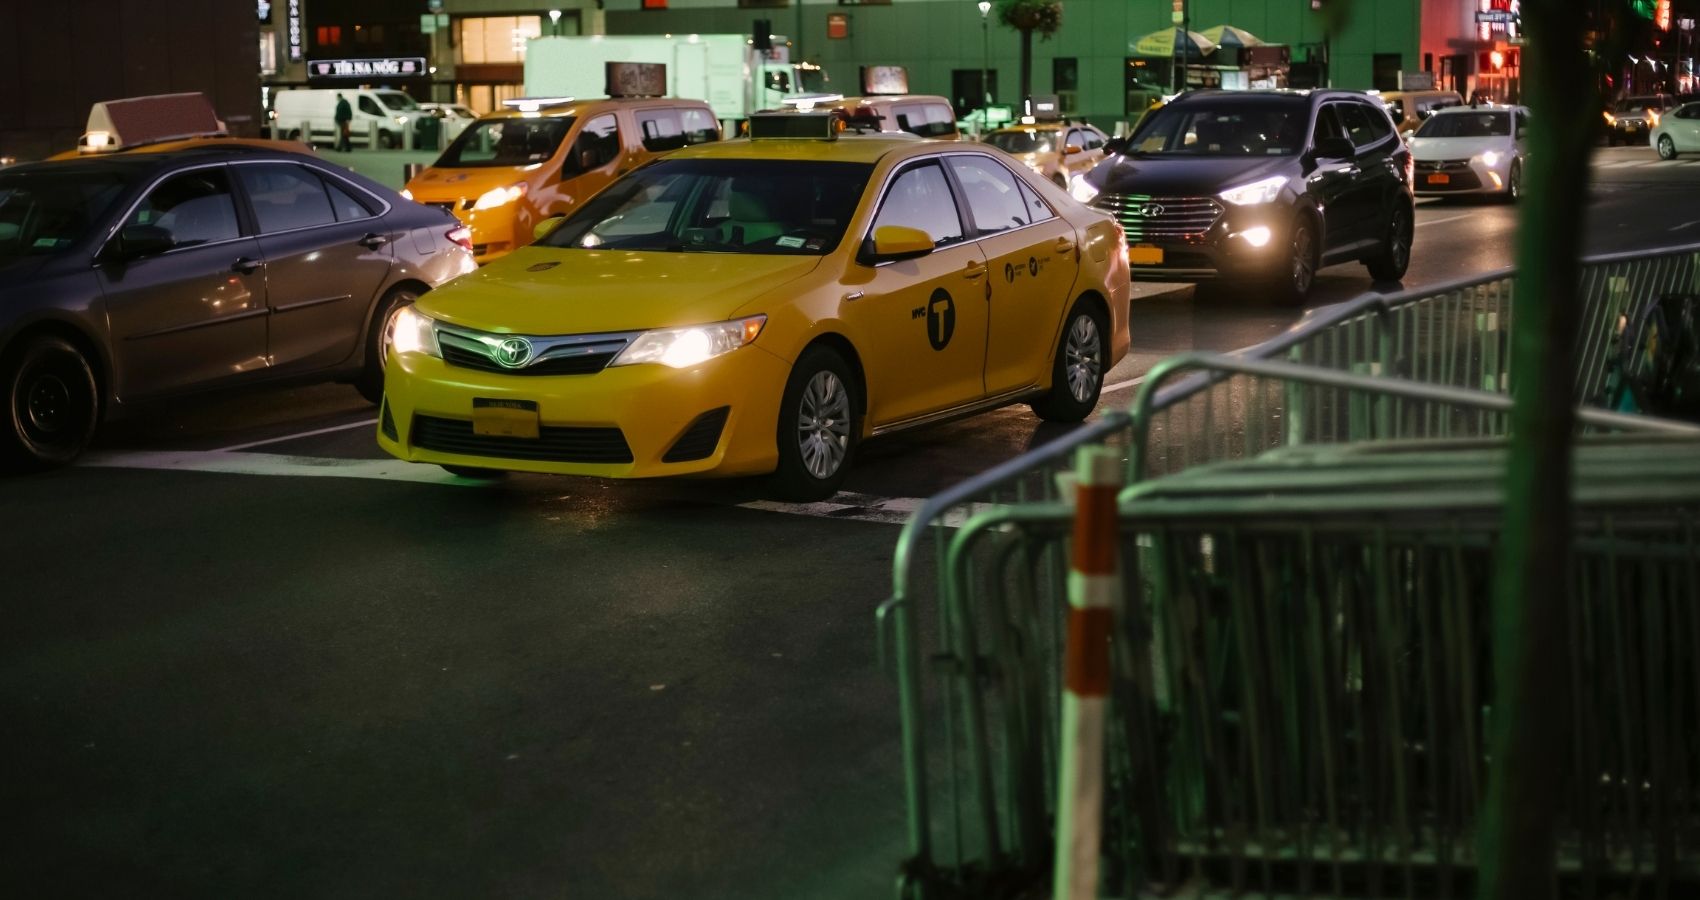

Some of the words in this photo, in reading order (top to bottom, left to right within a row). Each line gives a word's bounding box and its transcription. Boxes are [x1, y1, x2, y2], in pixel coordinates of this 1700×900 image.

[354, 61, 372, 75] NA
[911, 306, 926, 320] NYC
[933, 300, 949, 343] T
